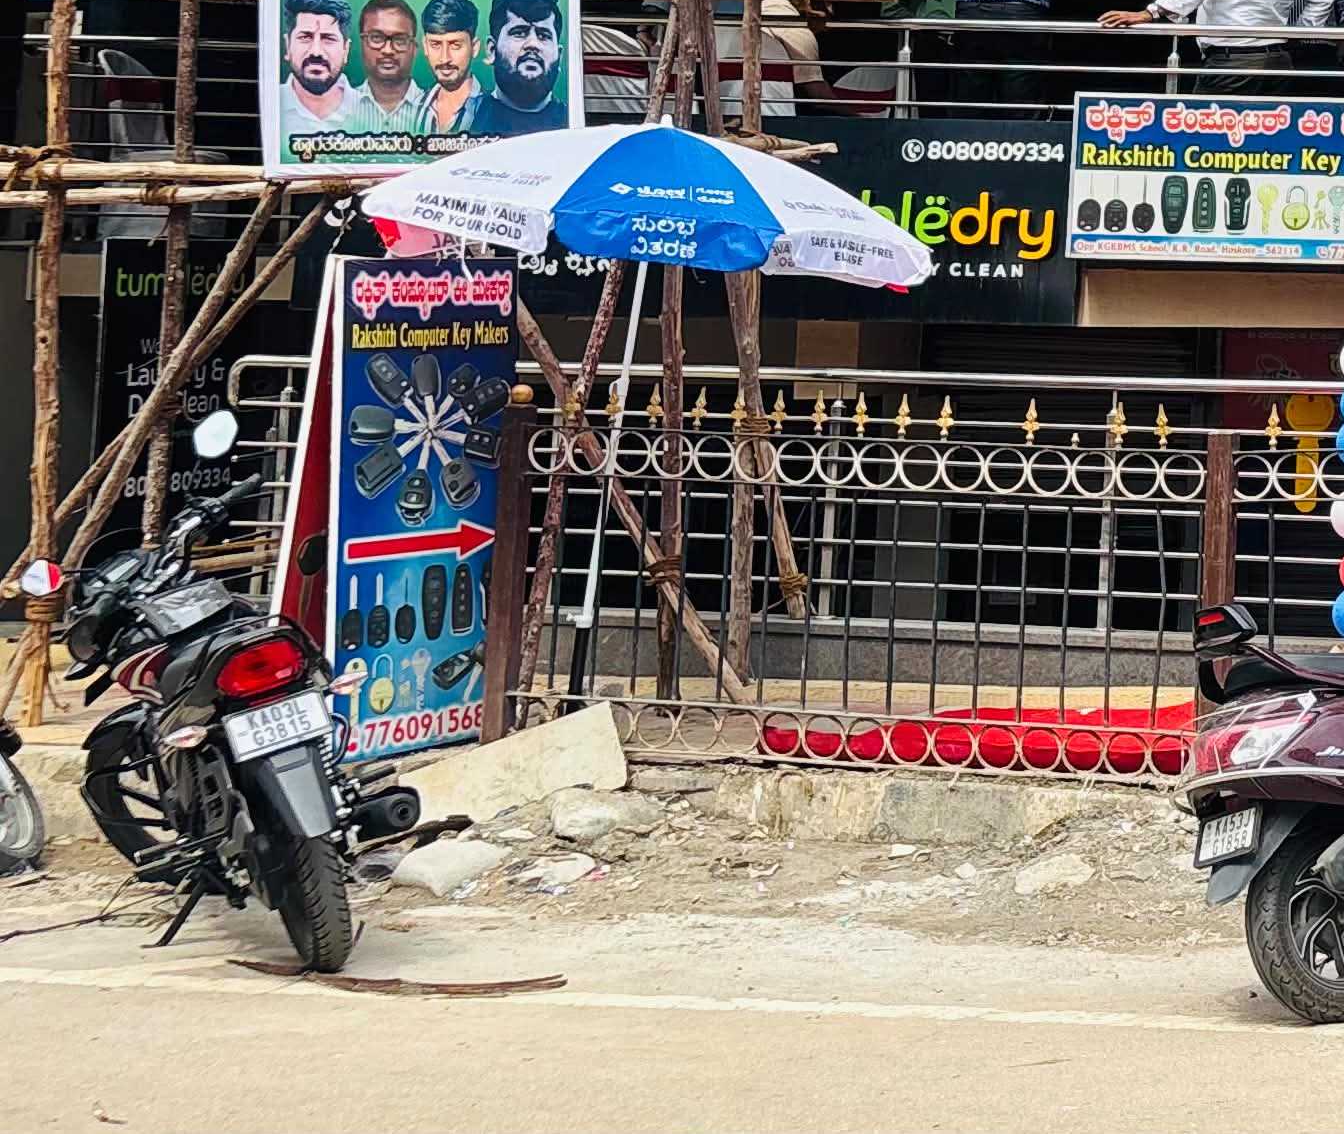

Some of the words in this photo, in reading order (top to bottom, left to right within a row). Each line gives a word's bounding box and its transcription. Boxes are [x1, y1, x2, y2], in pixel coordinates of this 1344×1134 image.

[927, 141, 1065, 163] 8080809334
[1082, 143, 1175, 168] Rakshith
[1184, 146, 1293, 174] Computer
[1301, 148, 1341, 176] Key
[412, 206, 444, 222] FOR
[448, 214, 482, 231] YOUR
[631, 214, 697, 239] ಸುಲಭ
[630, 235, 698, 259] ವಿತರಣೆ
[949, 262, 1024, 278] CLEAN
[352, 323, 397, 349] Rakshith
[399, 321, 450, 351] Computer
[452, 321, 473, 350] Key
[474, 321, 509, 347] Makers
[211, 357, 225, 382] &
[124, 467, 232, 498] 80809334
[364, 705, 483, 752] 776091568
